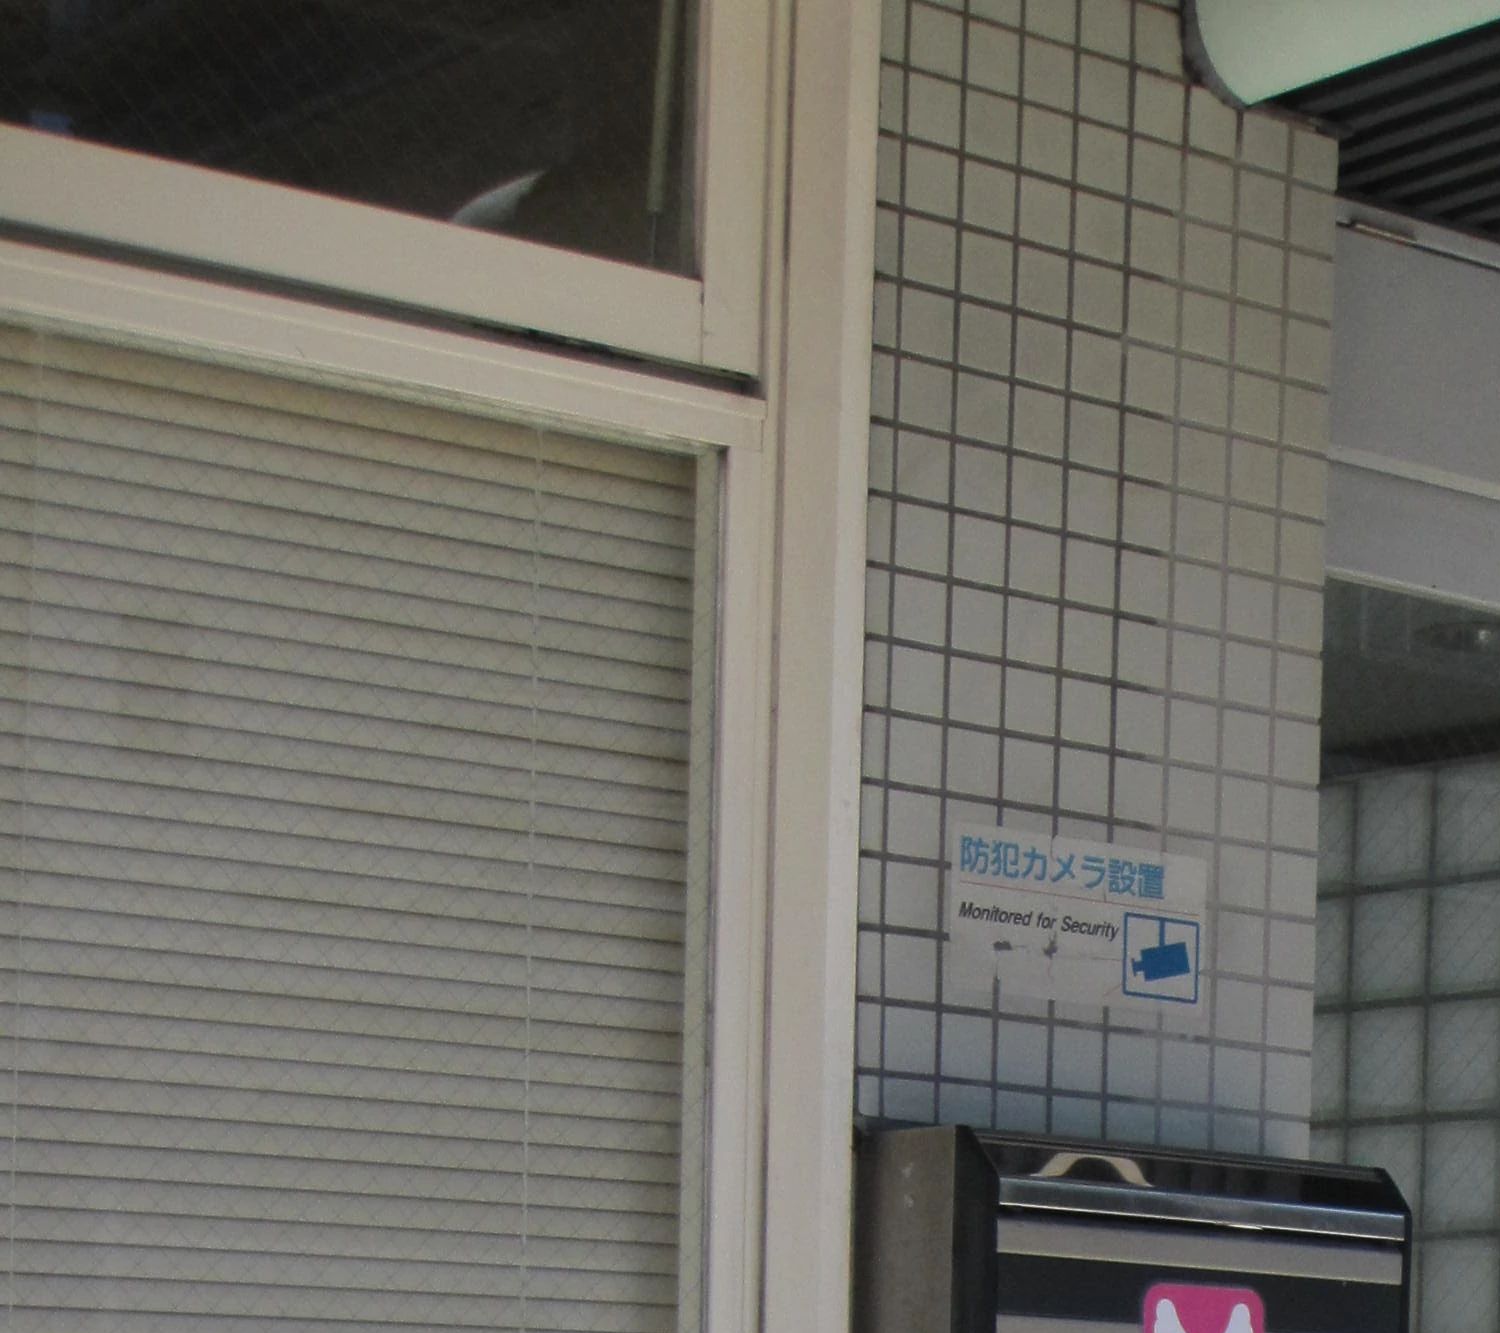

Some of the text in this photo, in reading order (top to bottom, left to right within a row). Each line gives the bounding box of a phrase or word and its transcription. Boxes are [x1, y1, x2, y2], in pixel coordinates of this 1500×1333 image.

[959, 834, 1165, 900] 防犯カメラ設置
[958, 901, 1119, 940] Monitored for Security
